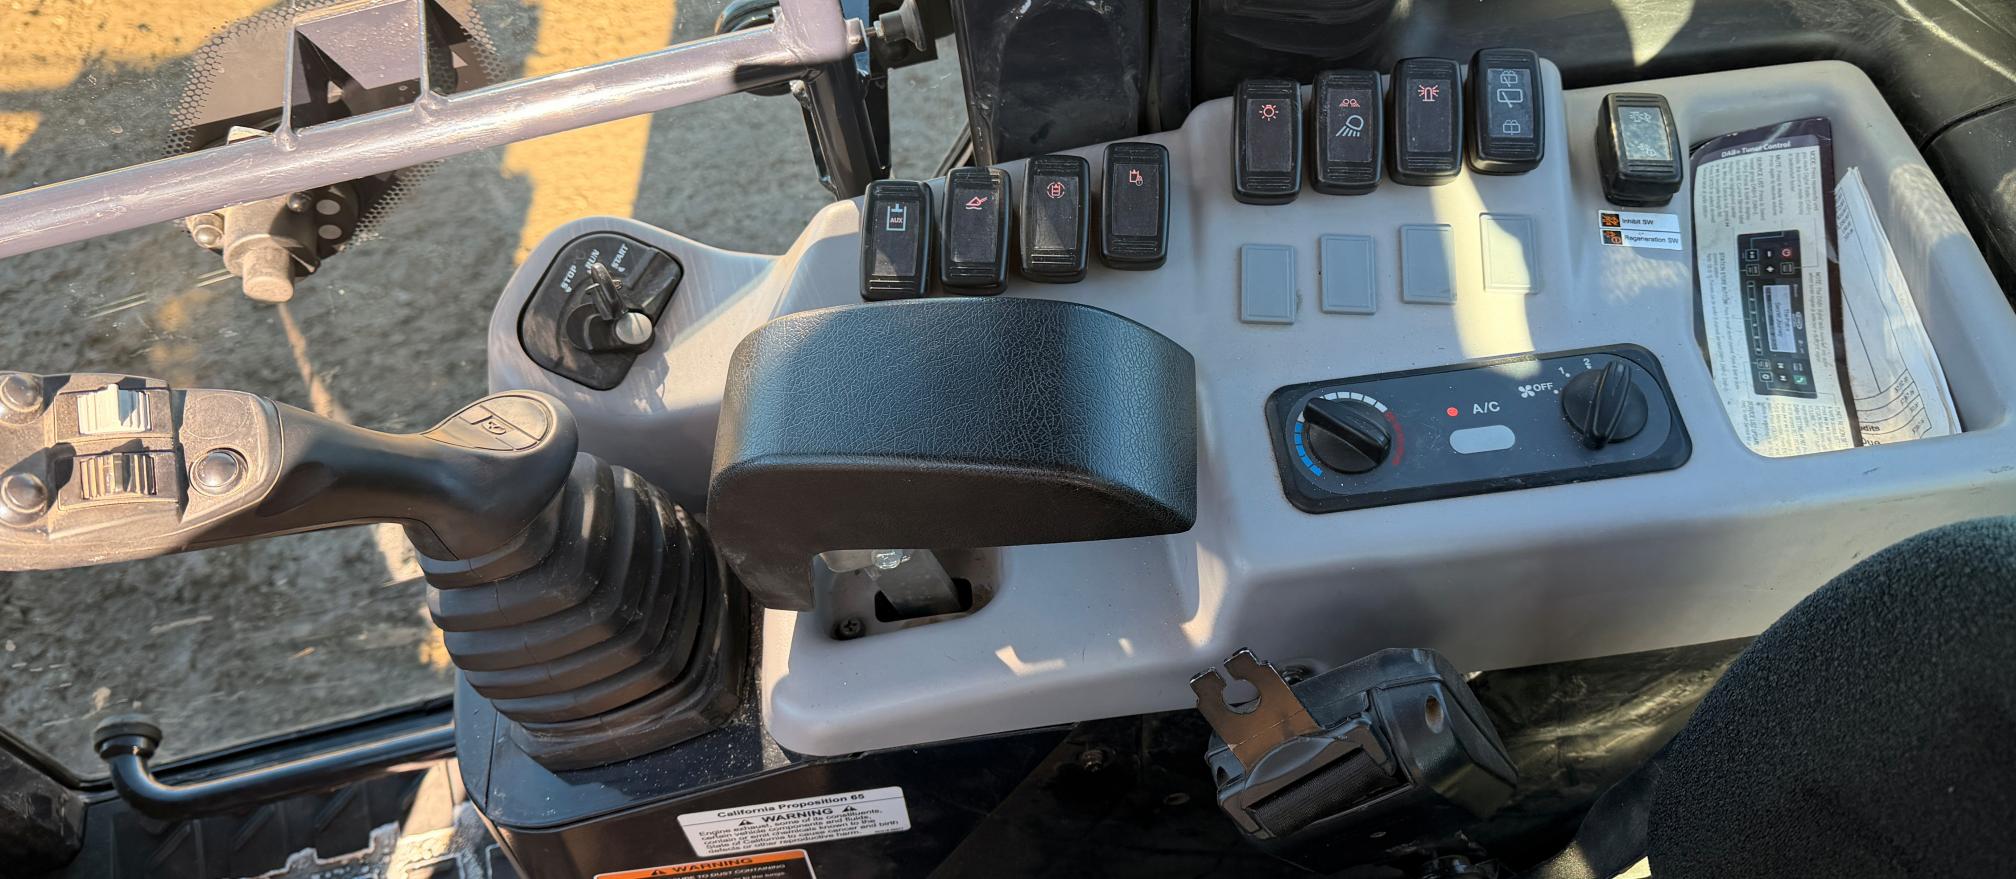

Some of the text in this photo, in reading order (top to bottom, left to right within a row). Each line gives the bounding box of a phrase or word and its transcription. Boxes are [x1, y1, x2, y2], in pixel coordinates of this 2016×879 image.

[1764, 140, 1791, 151] Control
[1624, 234, 1666, 243] Regeneration
[585, 249, 600, 269] RUN
[611, 243, 629, 268] START
[561, 264, 577, 289] STOP
[1583, 357, 1592, 366] 2
[1558, 366, 1565, 375] 1
[1533, 382, 1553, 392] OFF
[1472, 401, 1500, 415] A/C
[717, 806, 775, 818] California
[779, 796, 847, 810] Proposition
[762, 808, 833, 823] WARNING
[699, 829, 731, 837] Engine
[775, 819, 799, 827] some
[702, 832, 733, 841] certain
[735, 828, 766, 837] vehicle
[769, 821, 823, 832] components
[704, 837, 736, 845] contain
[772, 826, 816, 836] chemicals
[743, 836, 785, 845] California
[799, 830, 824, 838] cause
[827, 826, 857, 834] cancer
[708, 846, 742, 854] defects
[780, 833, 834, 845] reproductive
[672, 857, 753, 873] WARNING
[734, 864, 786, 874] CONTAINING
